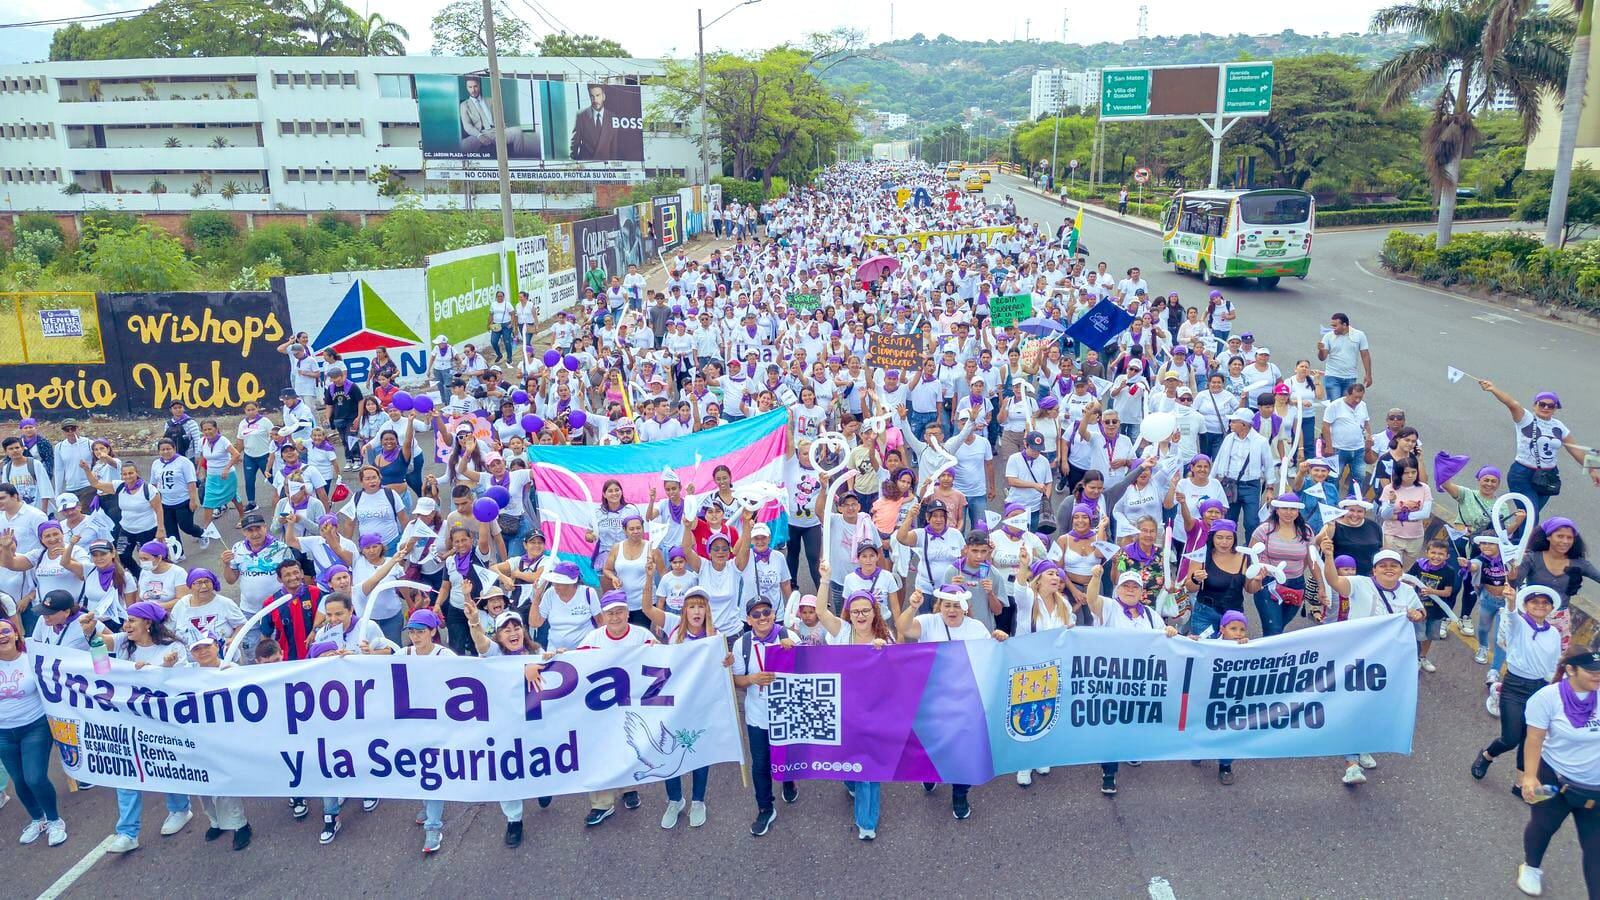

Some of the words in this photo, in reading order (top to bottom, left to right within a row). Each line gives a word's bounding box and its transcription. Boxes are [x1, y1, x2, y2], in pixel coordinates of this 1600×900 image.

[612, 117, 643, 129] BOSS
[477, 171, 515, 179] CONDUA
[517, 171, 562, 179] EMBRIAGADO,
[564, 171, 590, 179] PROTEJA
[128, 308, 284, 357] Wishops
[877, 334, 912, 346] RENTA
[1071, 654, 1168, 681] ALCALDÍA
[1212, 651, 1296, 673] Secretaría
[1299, 650, 1320, 664] de
[1071, 680, 1085, 696] DE
[1087, 680, 1113, 696] SAN
[1115, 678, 1147, 697] JOSÉ
[1151, 683, 1167, 697] DE
[1209, 660, 1336, 701] Equidad
[1344, 658, 1386, 692] de
[35, 654, 120, 713] Una
[126, 683, 268, 724] mano
[285, 678, 375, 735] por
[390, 663, 489, 722] La
[524, 660, 675, 721] Paz
[1071, 694, 1163, 727] CÚCUTA
[1205, 700, 1326, 732] Género
[84, 722, 129, 745] ALCALDÍA
[184, 738, 195, 749] de
[85, 740, 94, 750] DE
[94, 741, 106, 753] SAN
[122, 746, 132, 756] DE
[140, 743, 177, 761] Renta
[88, 751, 137, 777] CÚCUTA
[144, 760, 209, 783] Ciudadana
[280, 750, 304, 787] y
[317, 738, 357, 779] la
[368, 730, 579, 791] Seguridad
